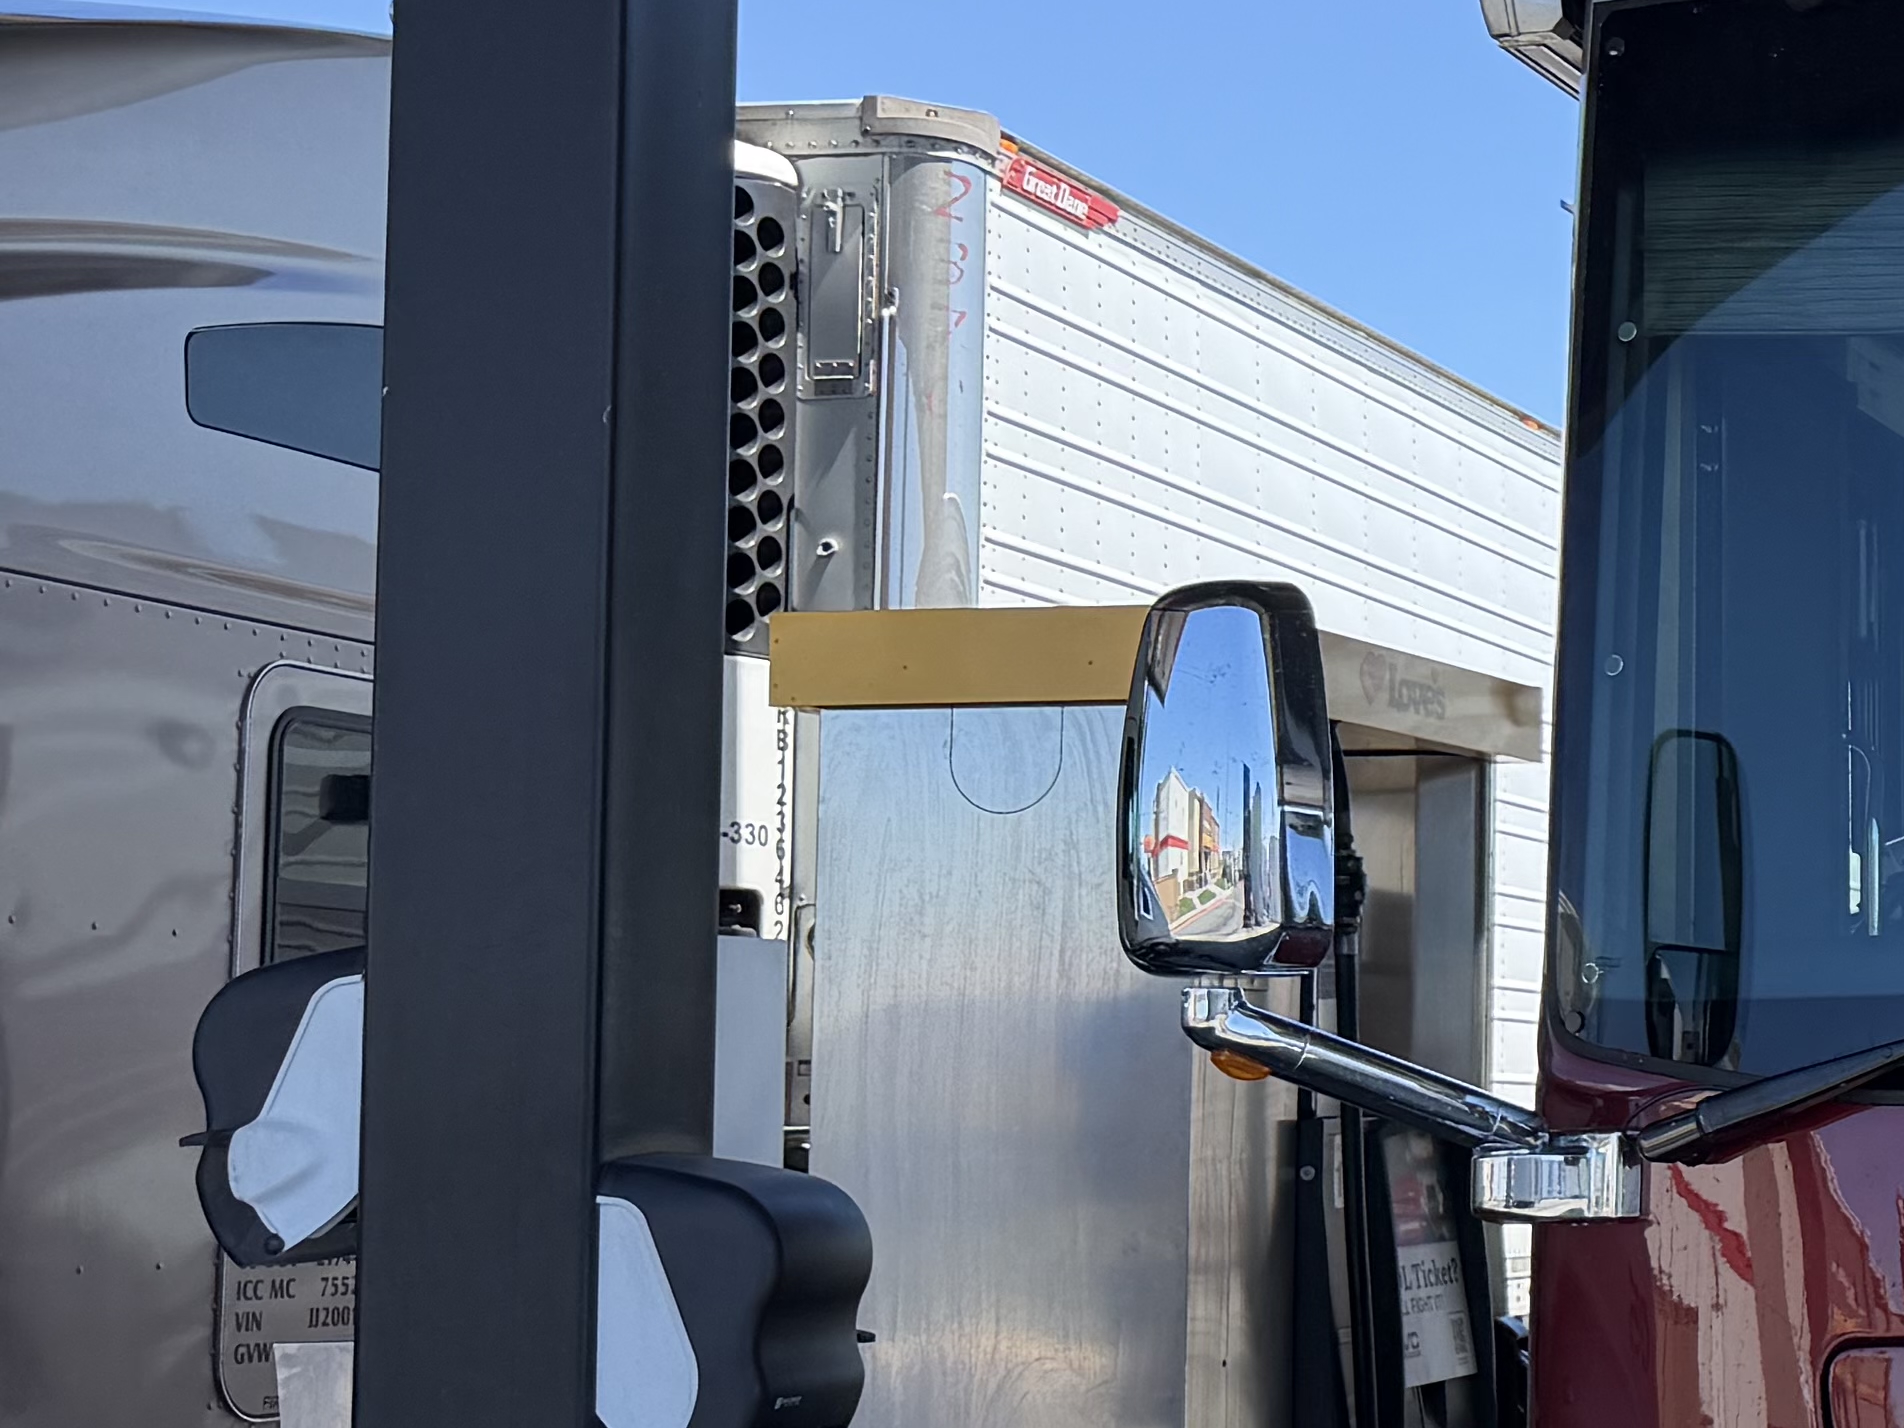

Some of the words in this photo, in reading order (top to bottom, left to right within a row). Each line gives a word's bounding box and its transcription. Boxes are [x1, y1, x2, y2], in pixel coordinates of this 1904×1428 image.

[1022, 165, 1059, 203] Great
[1058, 181, 1090, 220] Dane
[1412, 1257, 1459, 1290] Ticket?
[236, 1280, 264, 1301] ICC
[269, 1278, 296, 1300] MC
[235, 1311, 263, 1333] VIN
